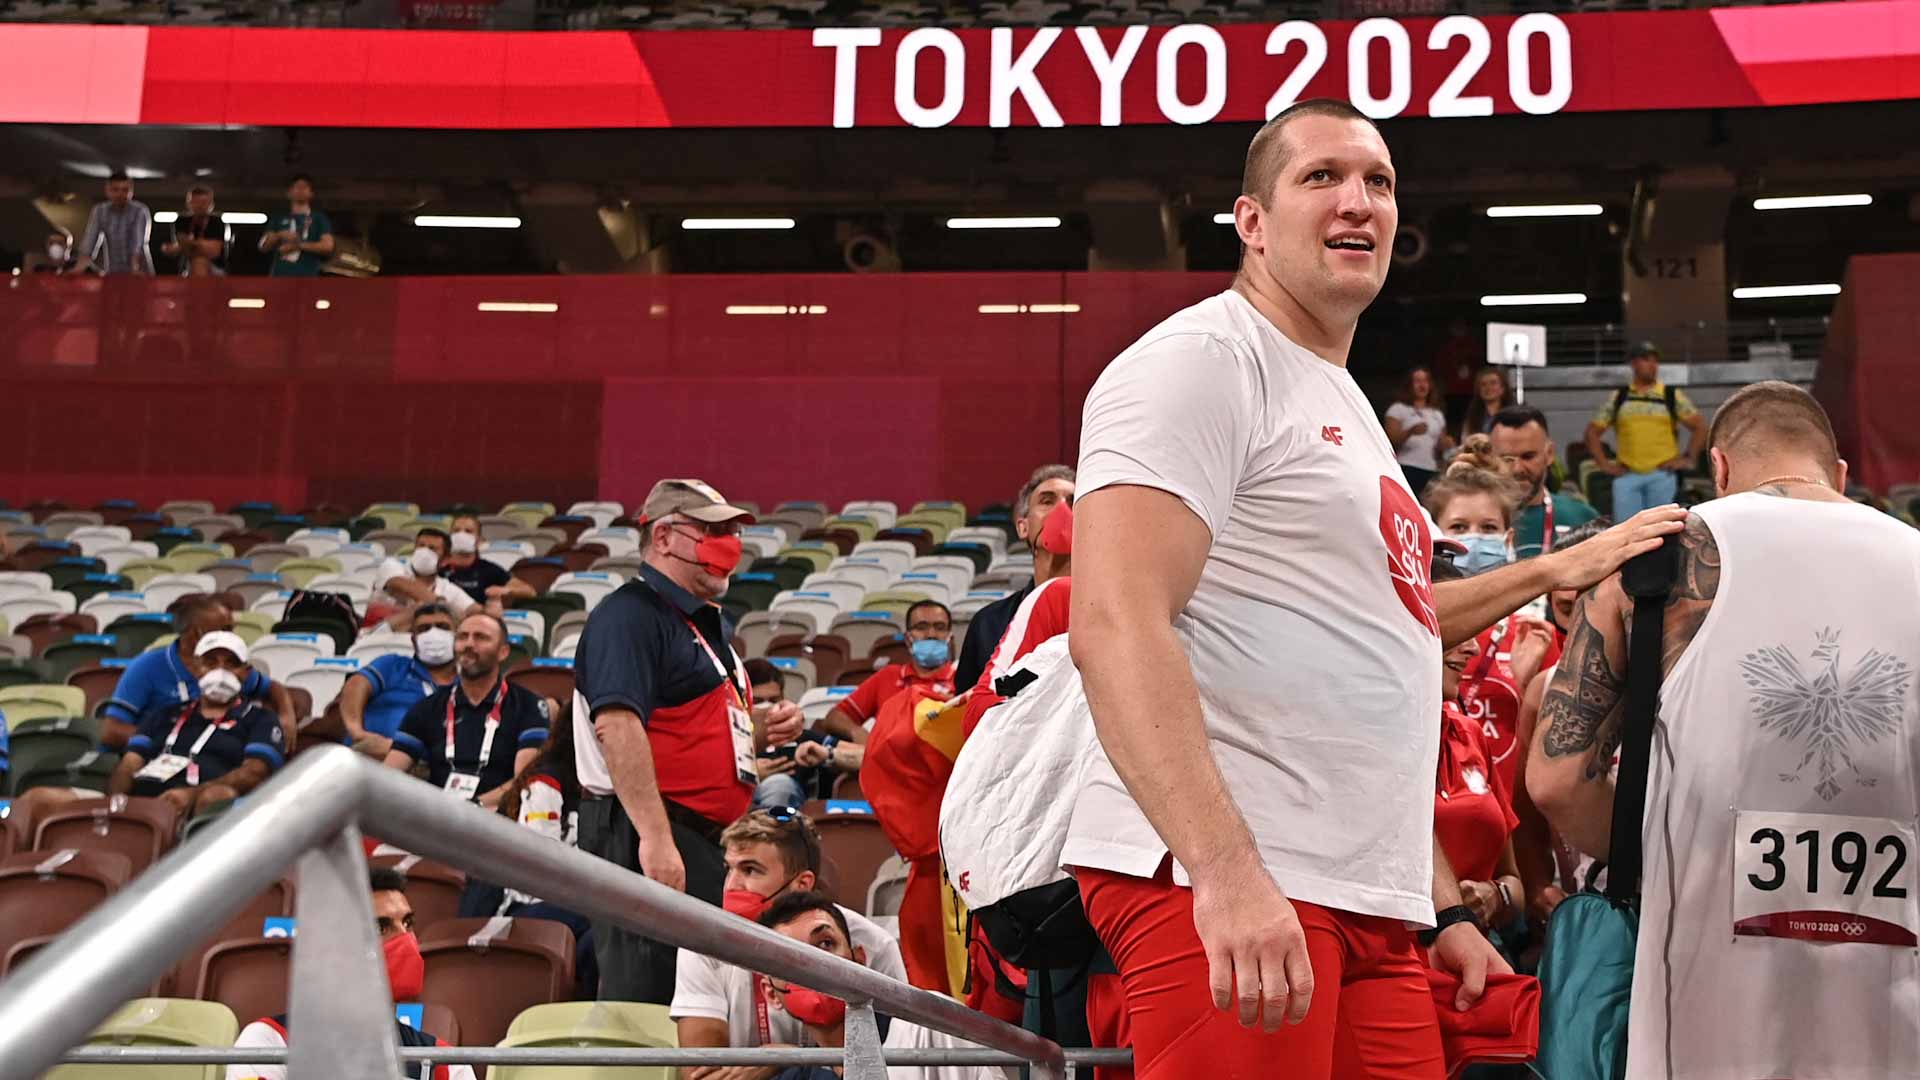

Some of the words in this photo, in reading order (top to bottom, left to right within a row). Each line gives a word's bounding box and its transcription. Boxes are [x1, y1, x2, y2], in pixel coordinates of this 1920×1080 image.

[813, 23, 1227, 128] TOKYO
[1265, 13, 1572, 122] 2020
[1656, 258, 1696, 278] 121
[1393, 512, 1423, 557] POL
[1748, 827, 1907, 898] 3192
[1789, 920, 1817, 931] TOKYO
[1818, 922, 1840, 932] 2020
